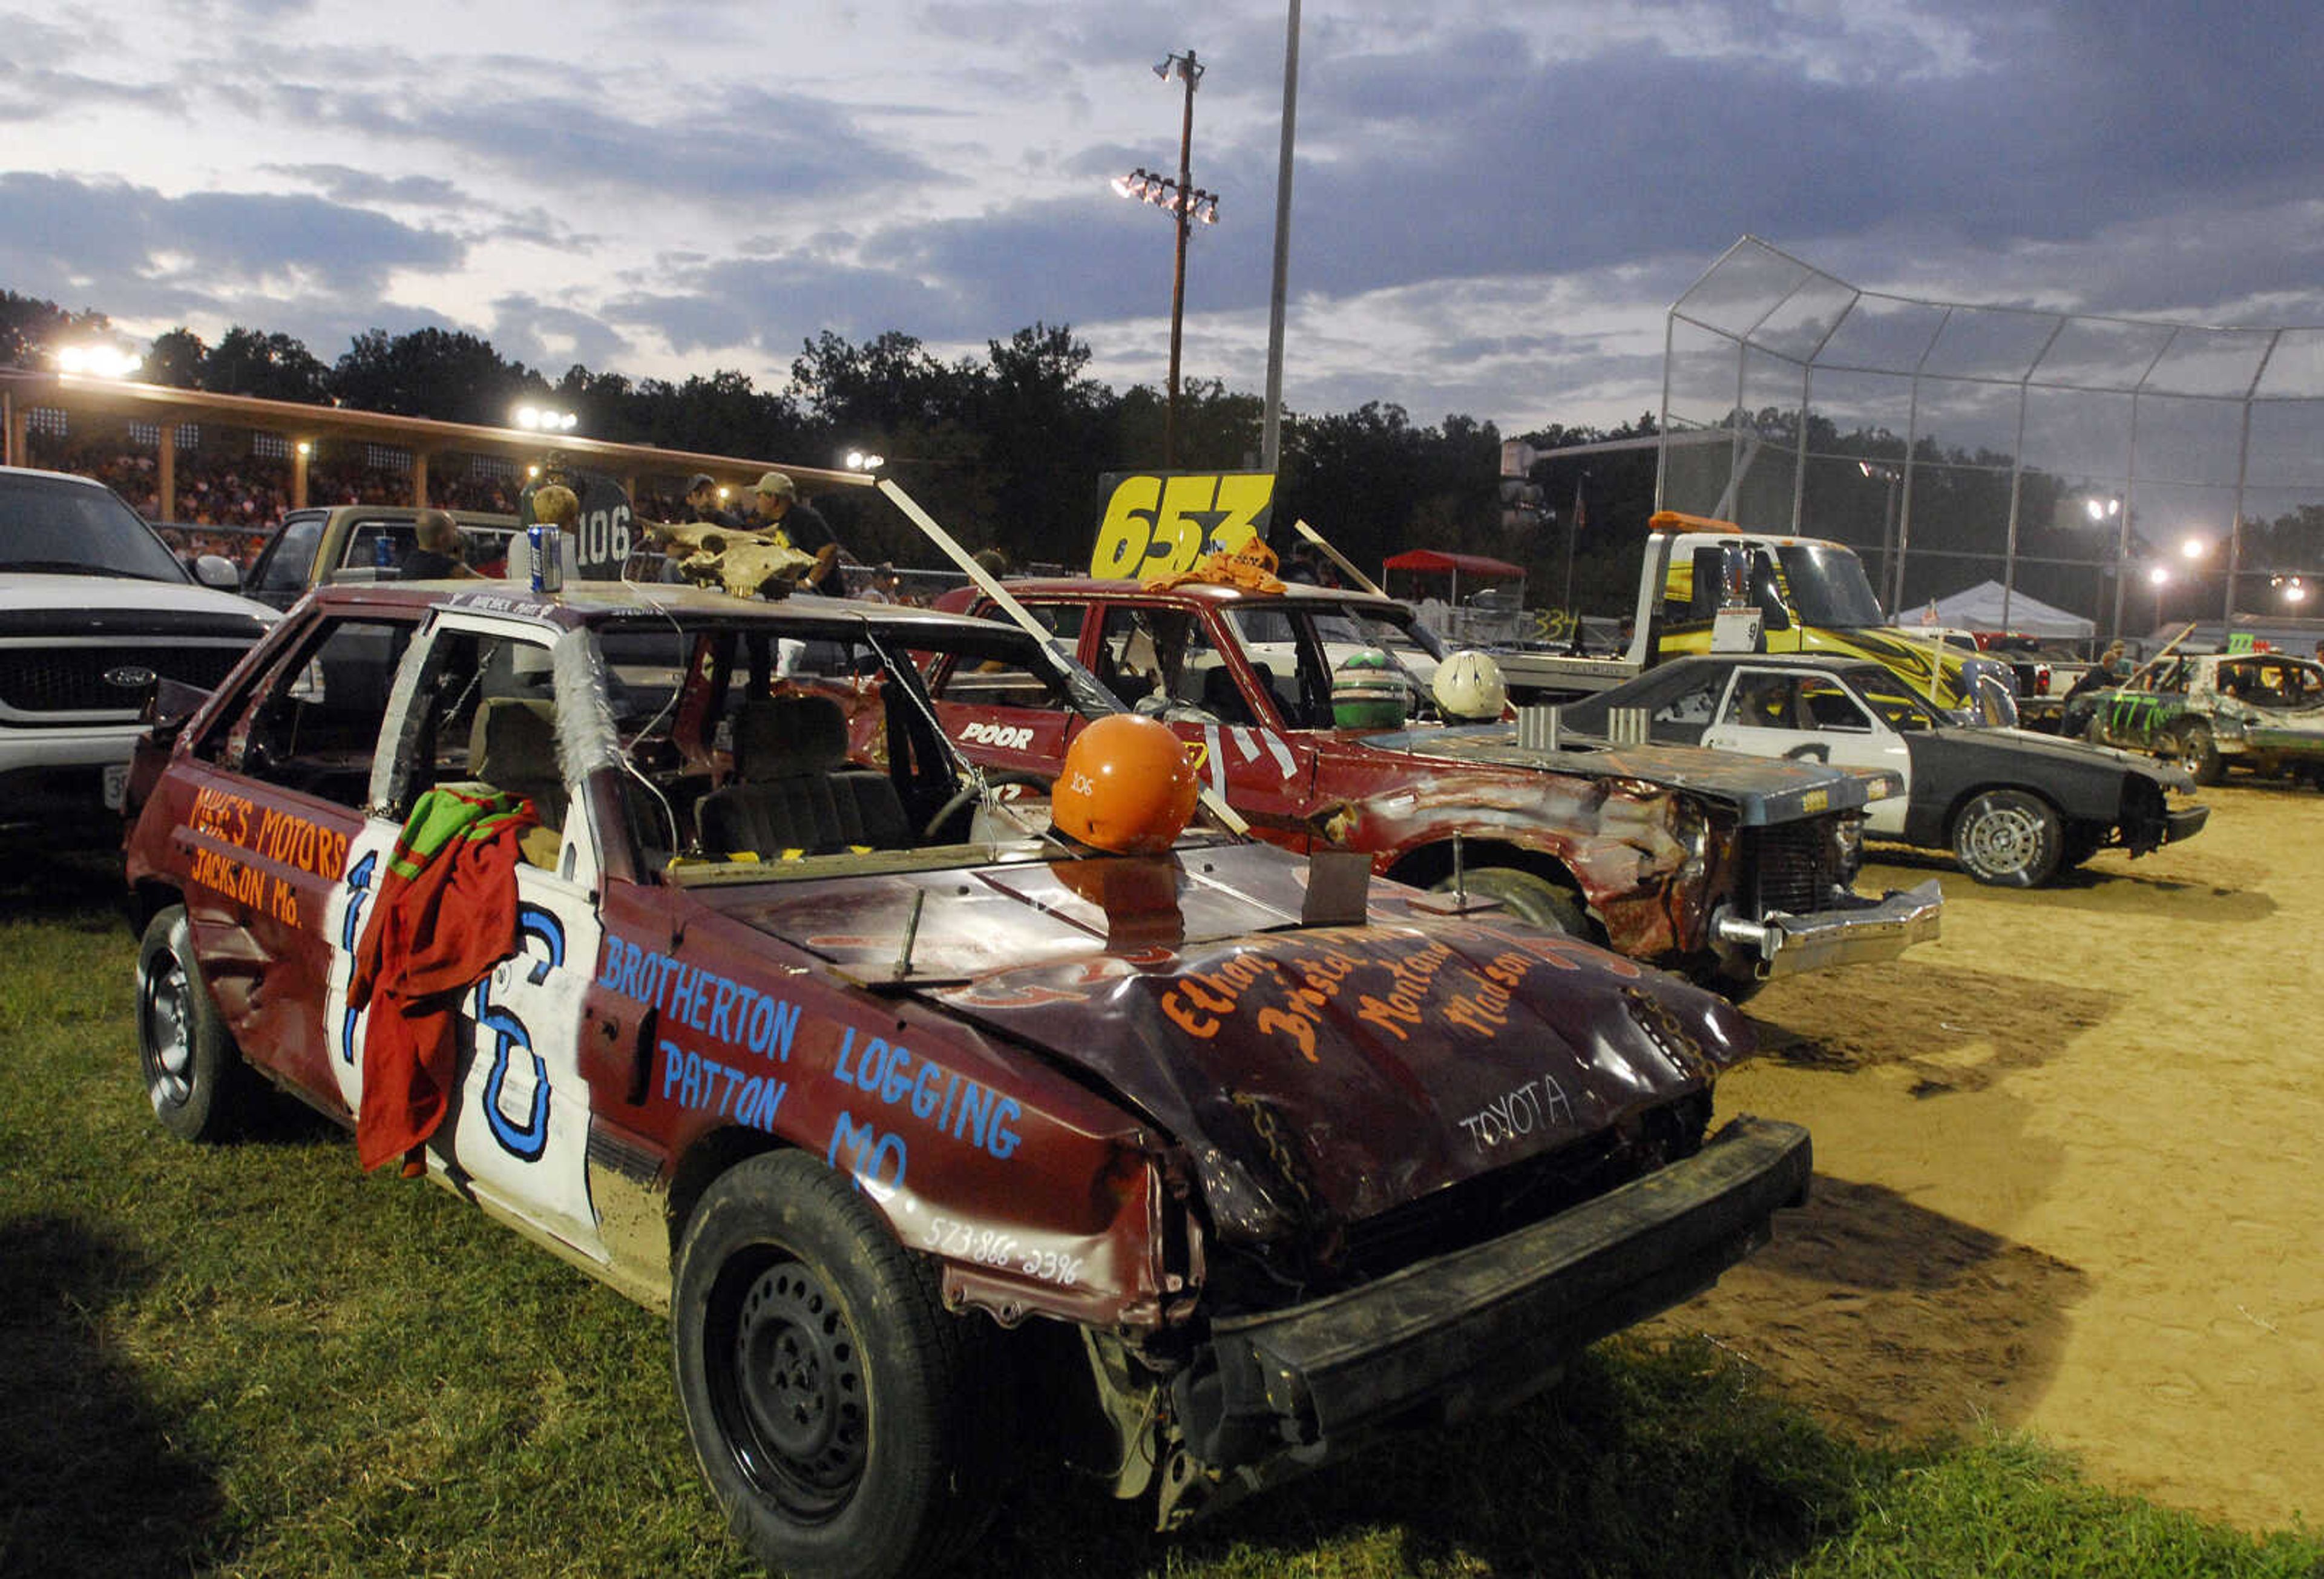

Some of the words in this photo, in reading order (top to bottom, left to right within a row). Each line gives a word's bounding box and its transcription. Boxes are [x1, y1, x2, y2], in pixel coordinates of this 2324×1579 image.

[577, 505, 631, 566] 106
[1091, 474, 1276, 579] 653
[958, 722, 1034, 750] POOR
[190, 786, 254, 847] MIKE'S
[256, 807, 347, 882] MOTORS
[192, 848, 266, 911] JACKSON
[597, 935, 802, 1063] BROTHERTON
[834, 1026, 1022, 1160] LOGGING
[659, 1039, 787, 1133] PATTON
[1459, 1074, 1575, 1154] TOYOTA
